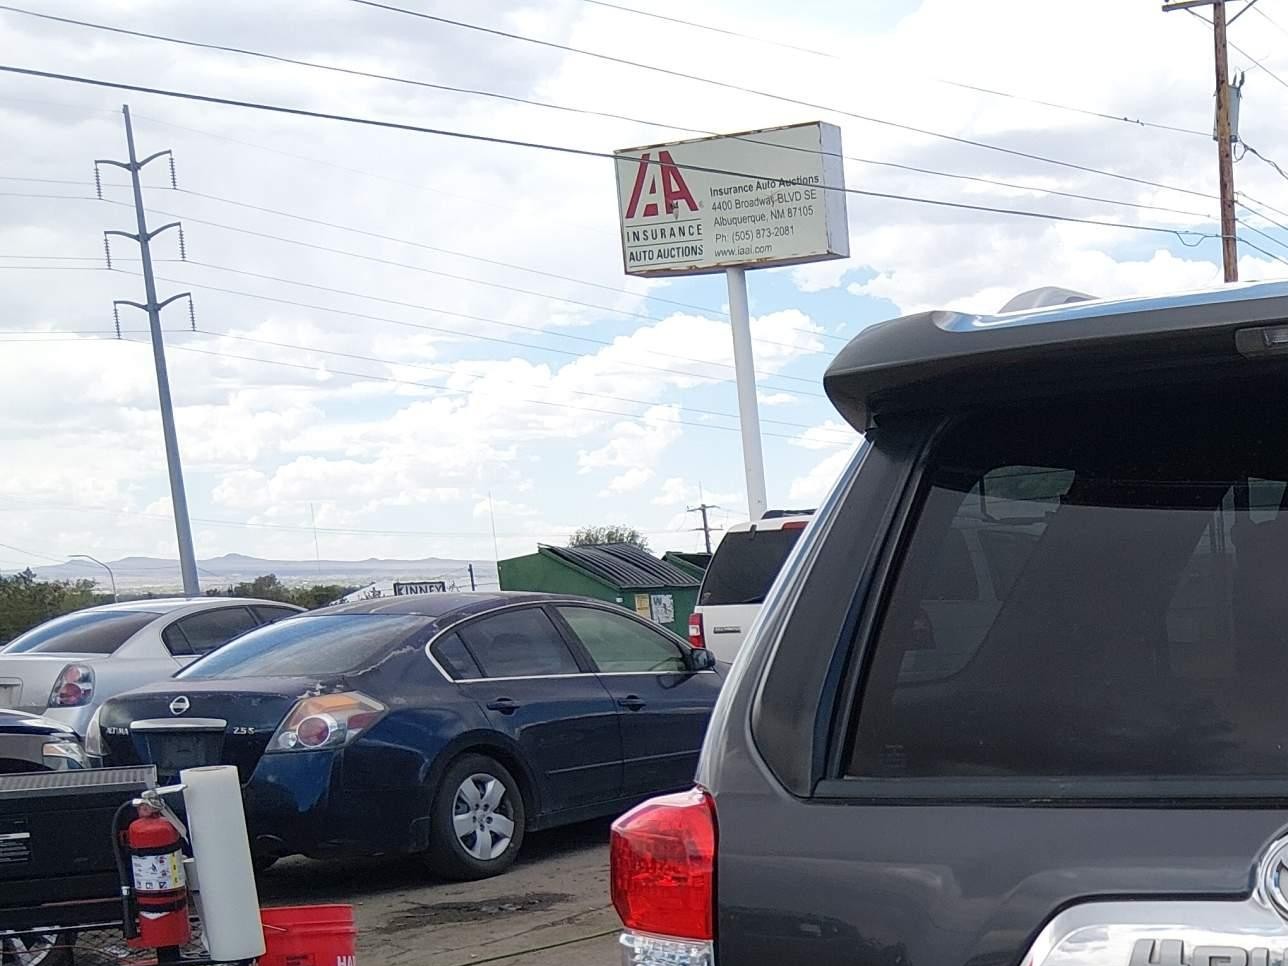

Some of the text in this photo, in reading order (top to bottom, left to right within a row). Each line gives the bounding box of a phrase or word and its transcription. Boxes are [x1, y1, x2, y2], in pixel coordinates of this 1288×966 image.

[710, 175, 819, 197] Insurance Auto Auctions
[712, 189, 817, 211] 4400 Broadway BLVD SE
[714, 205, 814, 227] Albuquerque, NM 87105
[626, 223, 703, 243] INSURANCE
[715, 225, 794, 244] Ph: (505) 873-2081
[629, 244, 704, 263] AUTO AUCTIONS
[714, 244, 773, 258] www.iaai.com
